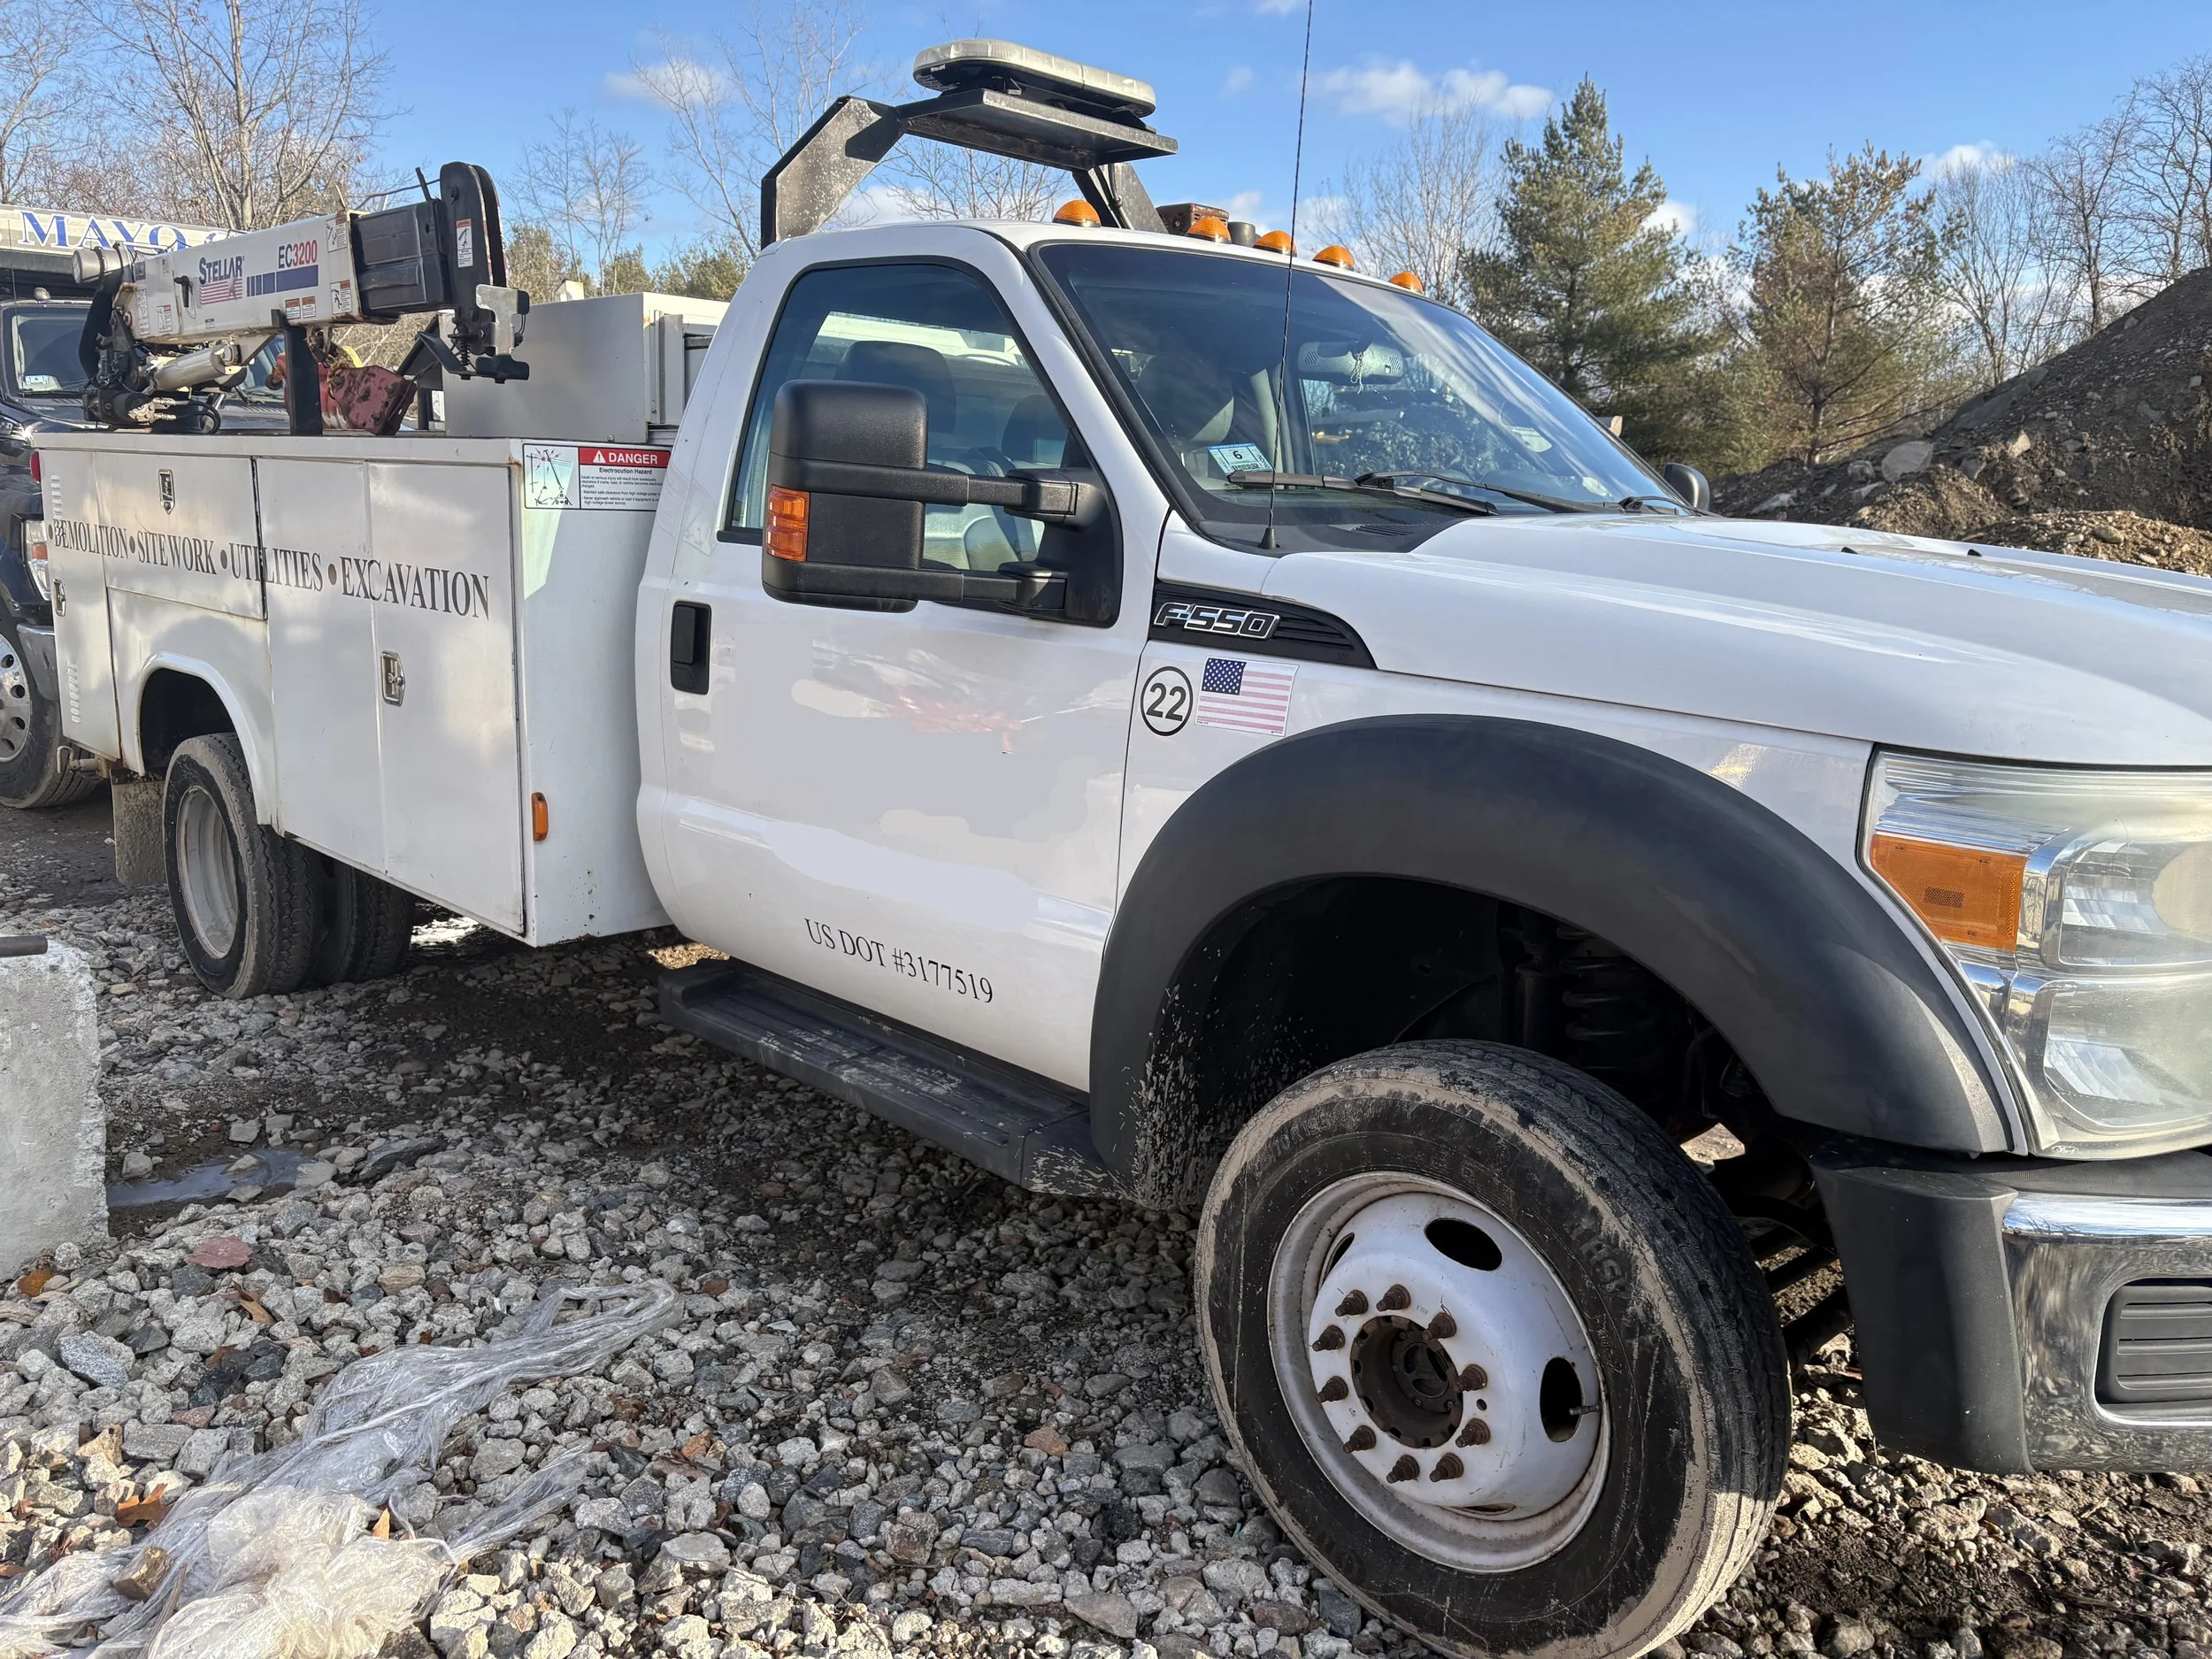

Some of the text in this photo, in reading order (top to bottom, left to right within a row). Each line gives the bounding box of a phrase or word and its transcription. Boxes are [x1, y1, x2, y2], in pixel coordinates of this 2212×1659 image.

[16, 211, 188, 251] MAYO
[279, 240, 318, 269] EC3200
[608, 452, 658, 465] DANGER
[1233, 450, 1243, 460] 6
[228, 542, 324, 592] UTILITIES
[339, 556, 489, 621] EXCAVATION
[1154, 602, 1280, 640] F-550
[1146, 682, 1187, 722] 22
[804, 918, 994, 1003] US DOT #3177519
